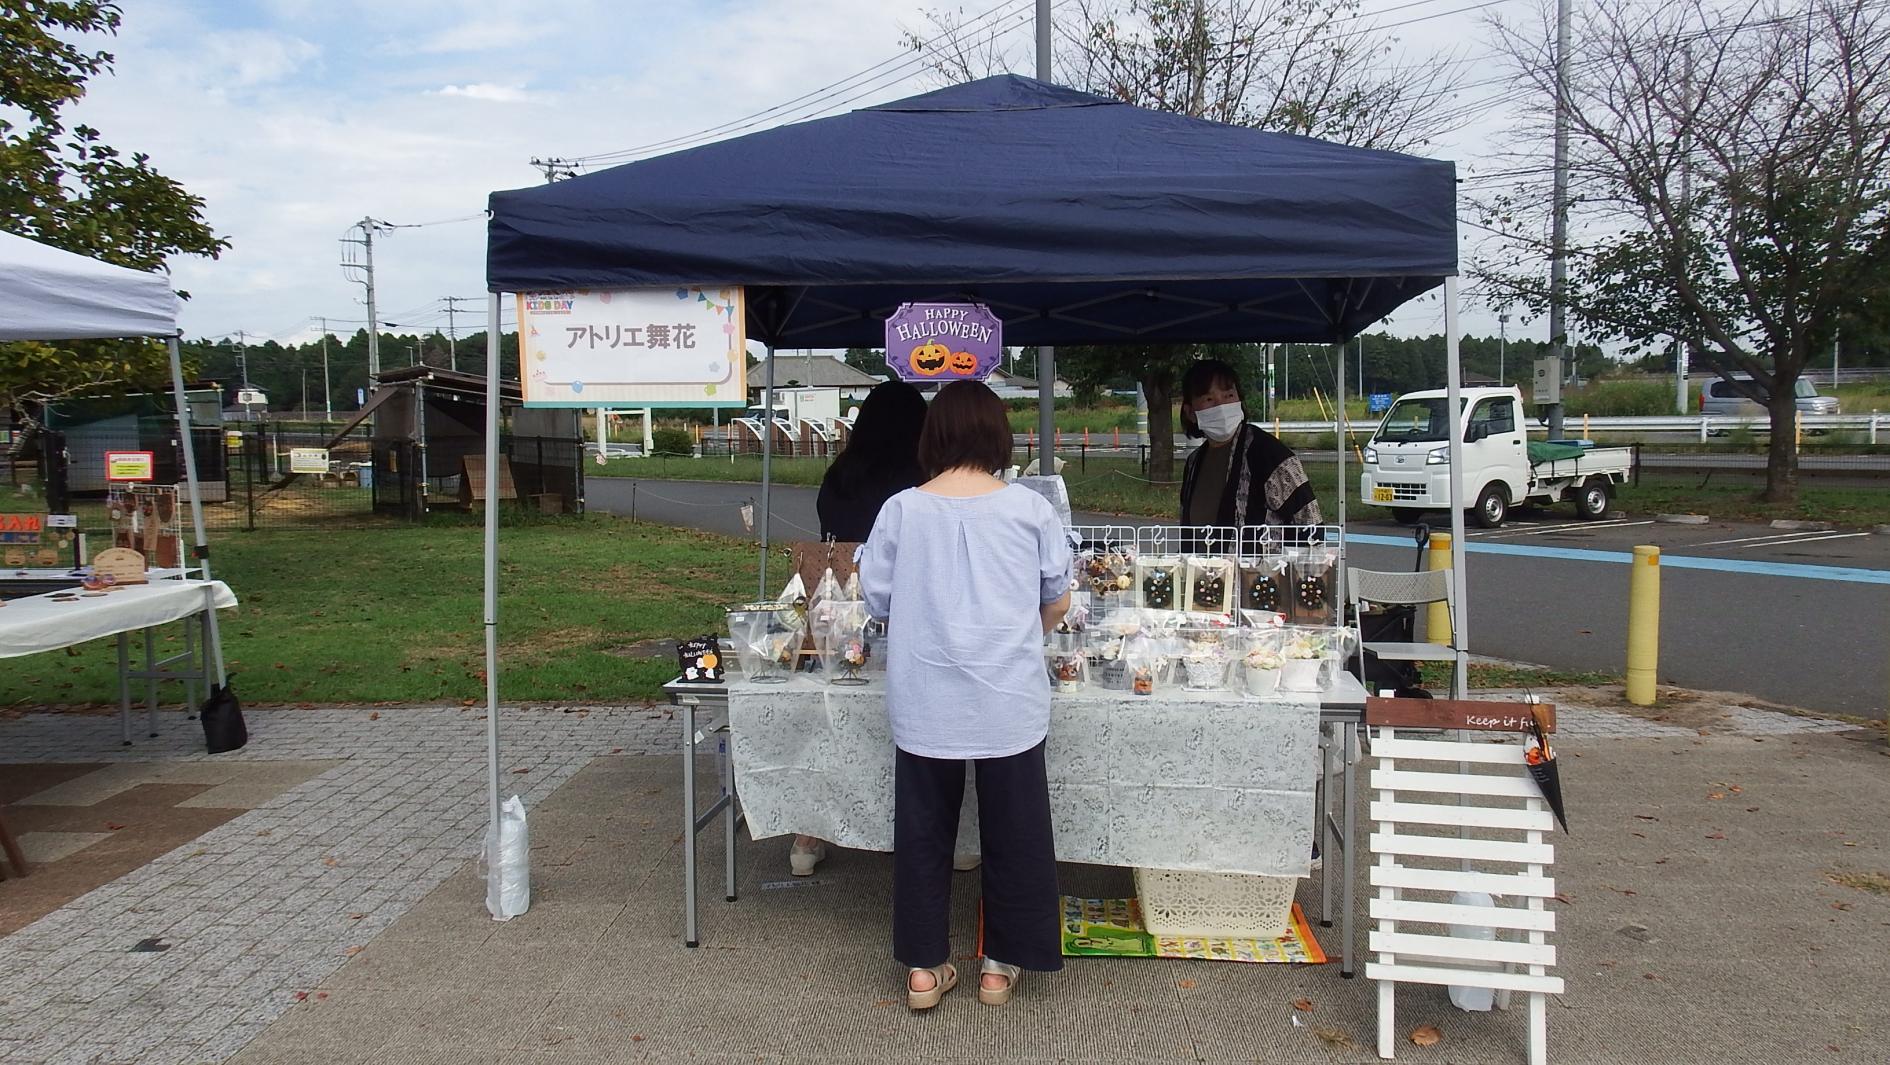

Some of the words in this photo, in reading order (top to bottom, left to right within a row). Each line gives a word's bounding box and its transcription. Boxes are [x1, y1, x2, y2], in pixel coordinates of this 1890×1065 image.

[553, 300, 574, 310] DAY
[924, 308, 968, 321] HAPPY
[565, 323, 696, 349] アトリエ舞花
[896, 320, 992, 344] HALLOWEEN
[1503, 716, 1518, 727] it
